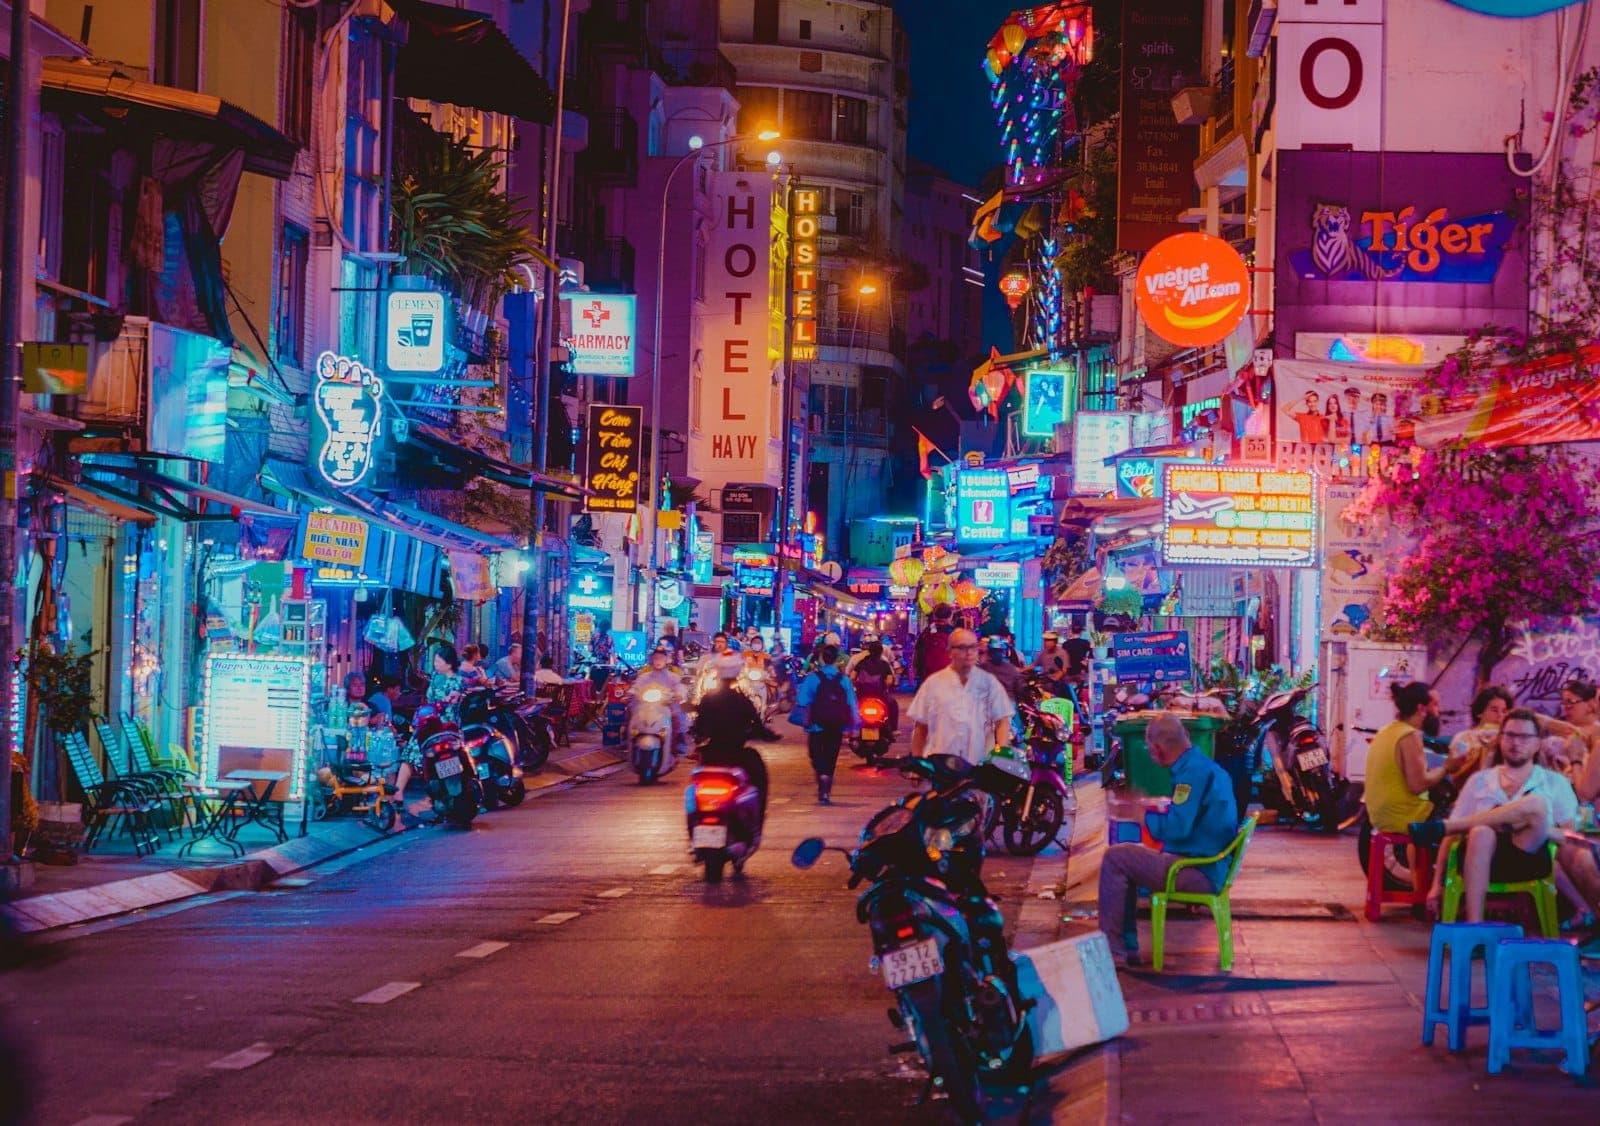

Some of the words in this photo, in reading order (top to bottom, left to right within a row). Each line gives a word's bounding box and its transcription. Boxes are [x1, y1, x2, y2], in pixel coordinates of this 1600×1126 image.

[1141, 42, 1175, 56] spirits
[1361, 206, 1493, 273] Tiger
[796, 192, 816, 341] HOSTEL
[723, 196, 757, 420] HOTEL
[572, 334, 631, 350] ARMACY
[1248, 438, 1265, 452] 55
